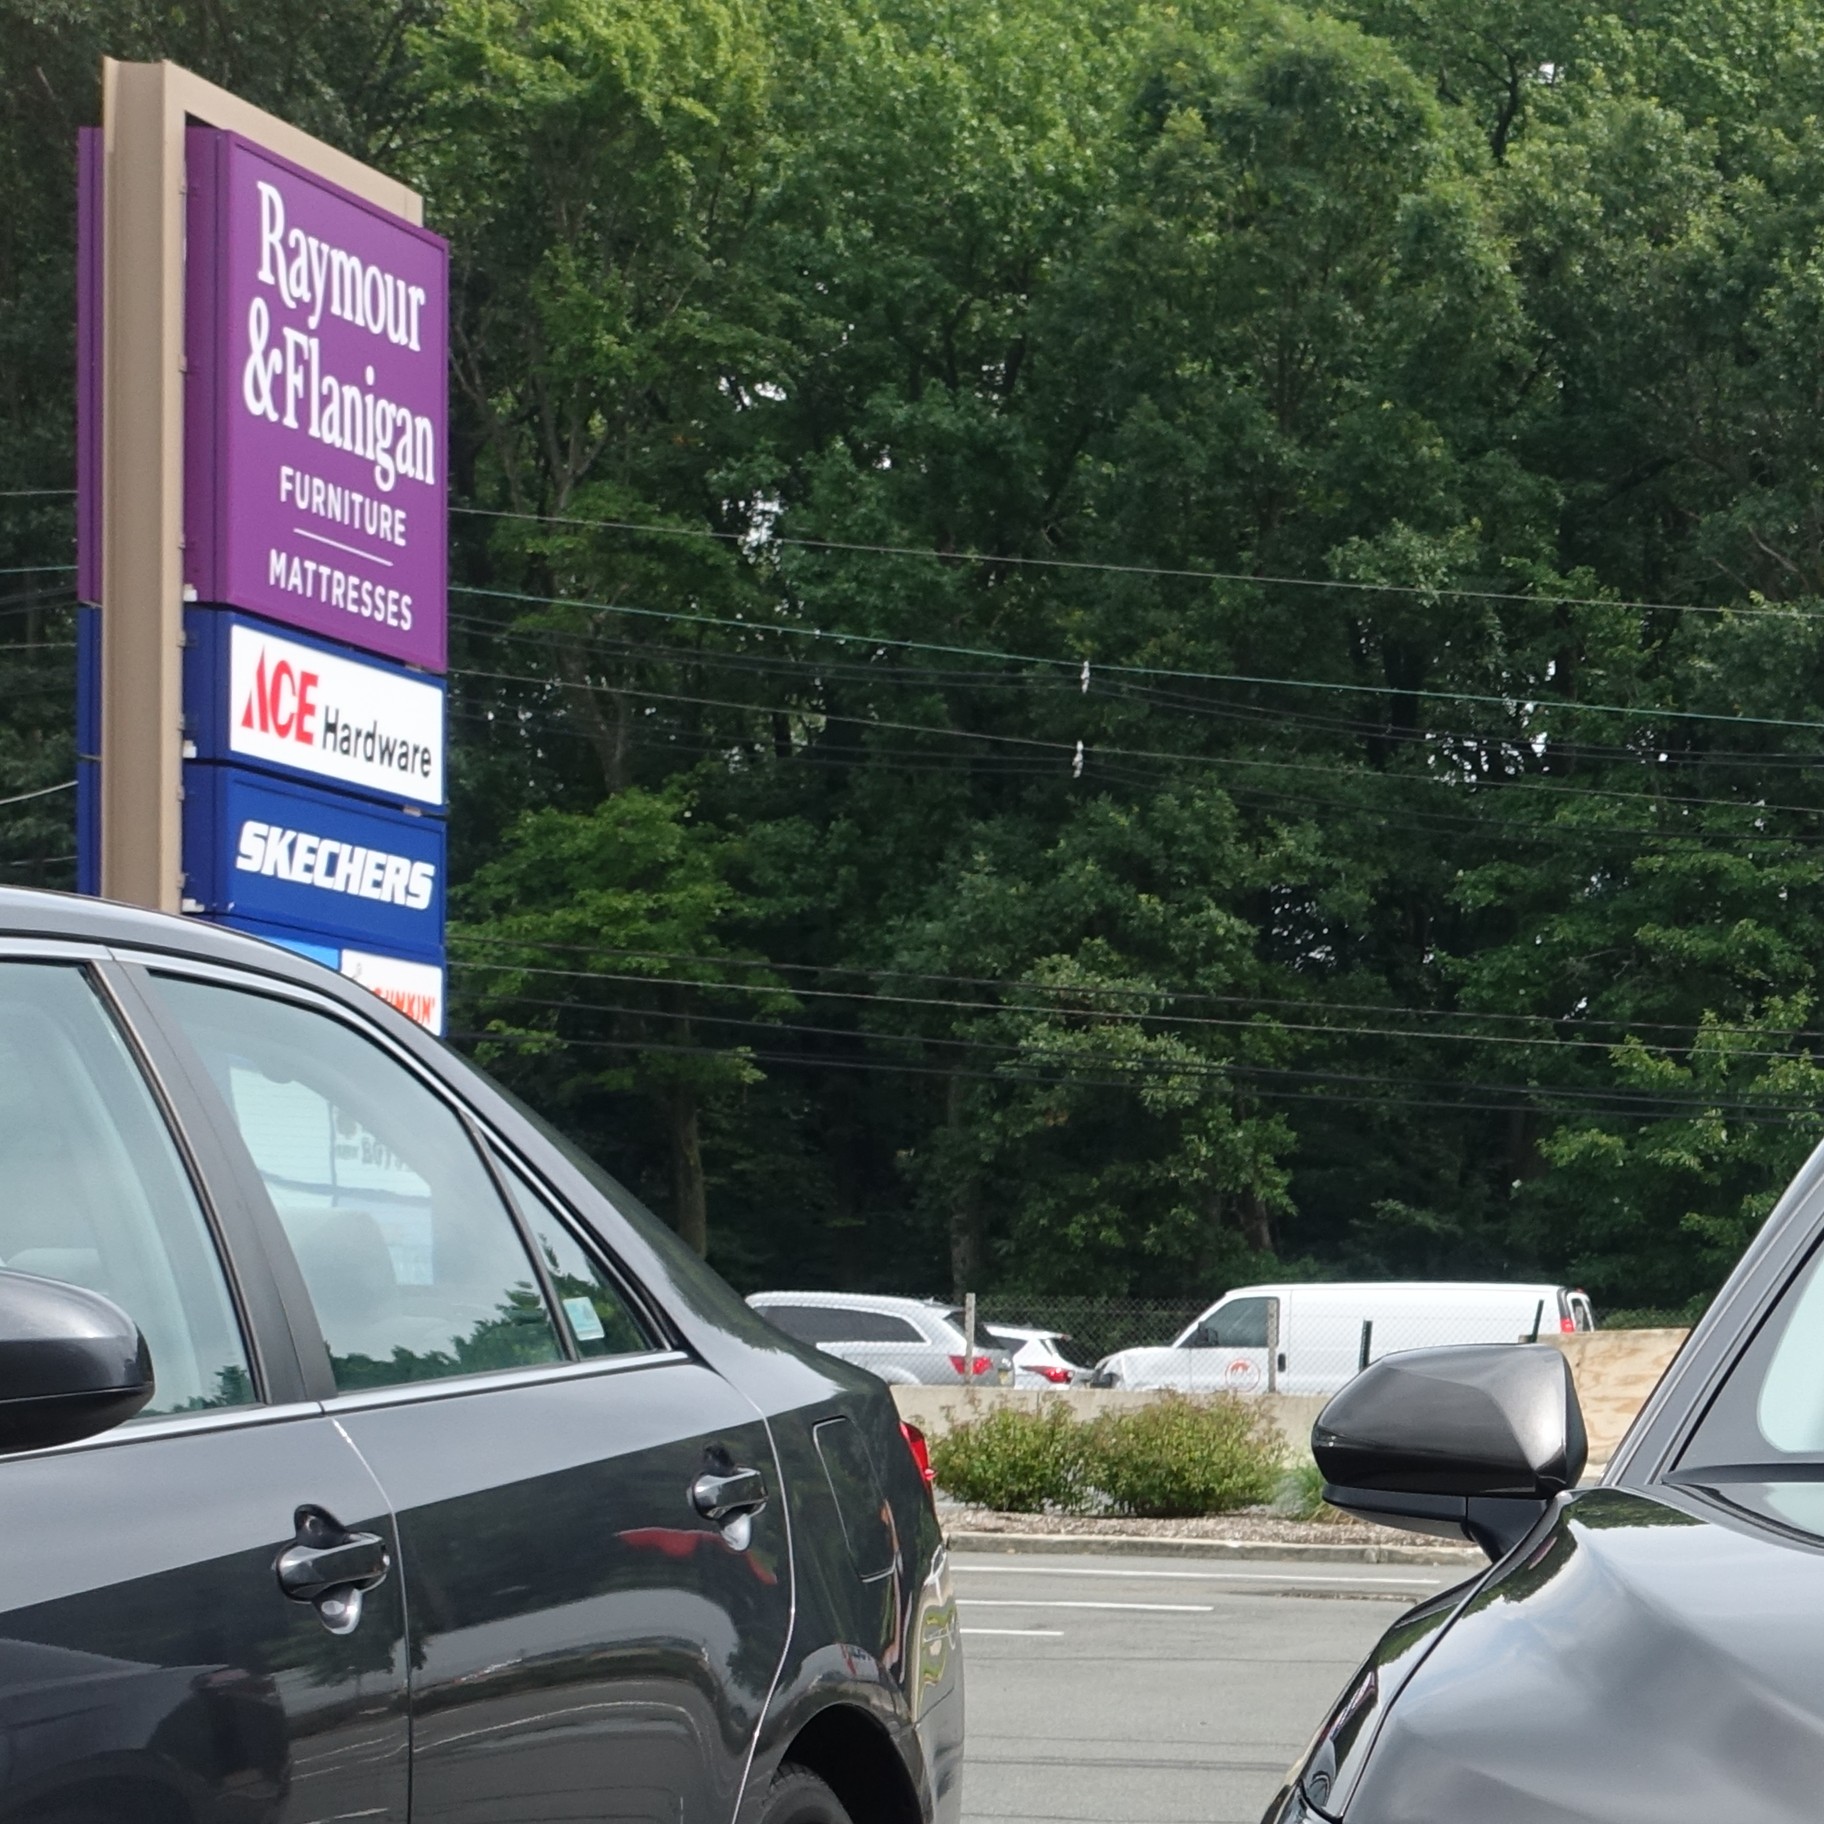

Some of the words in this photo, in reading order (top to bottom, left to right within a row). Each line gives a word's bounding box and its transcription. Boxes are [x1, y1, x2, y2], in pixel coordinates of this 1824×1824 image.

[257, 181, 426, 351] Raymour
[243, 297, 435, 492] &Flanigan
[280, 466, 407, 547] FURNITURE
[269, 549, 413, 631] MATTRESSES
[241, 645, 319, 746] ACE
[321, 704, 432, 779] Hardware
[235, 819, 436, 910] SKECHERS
